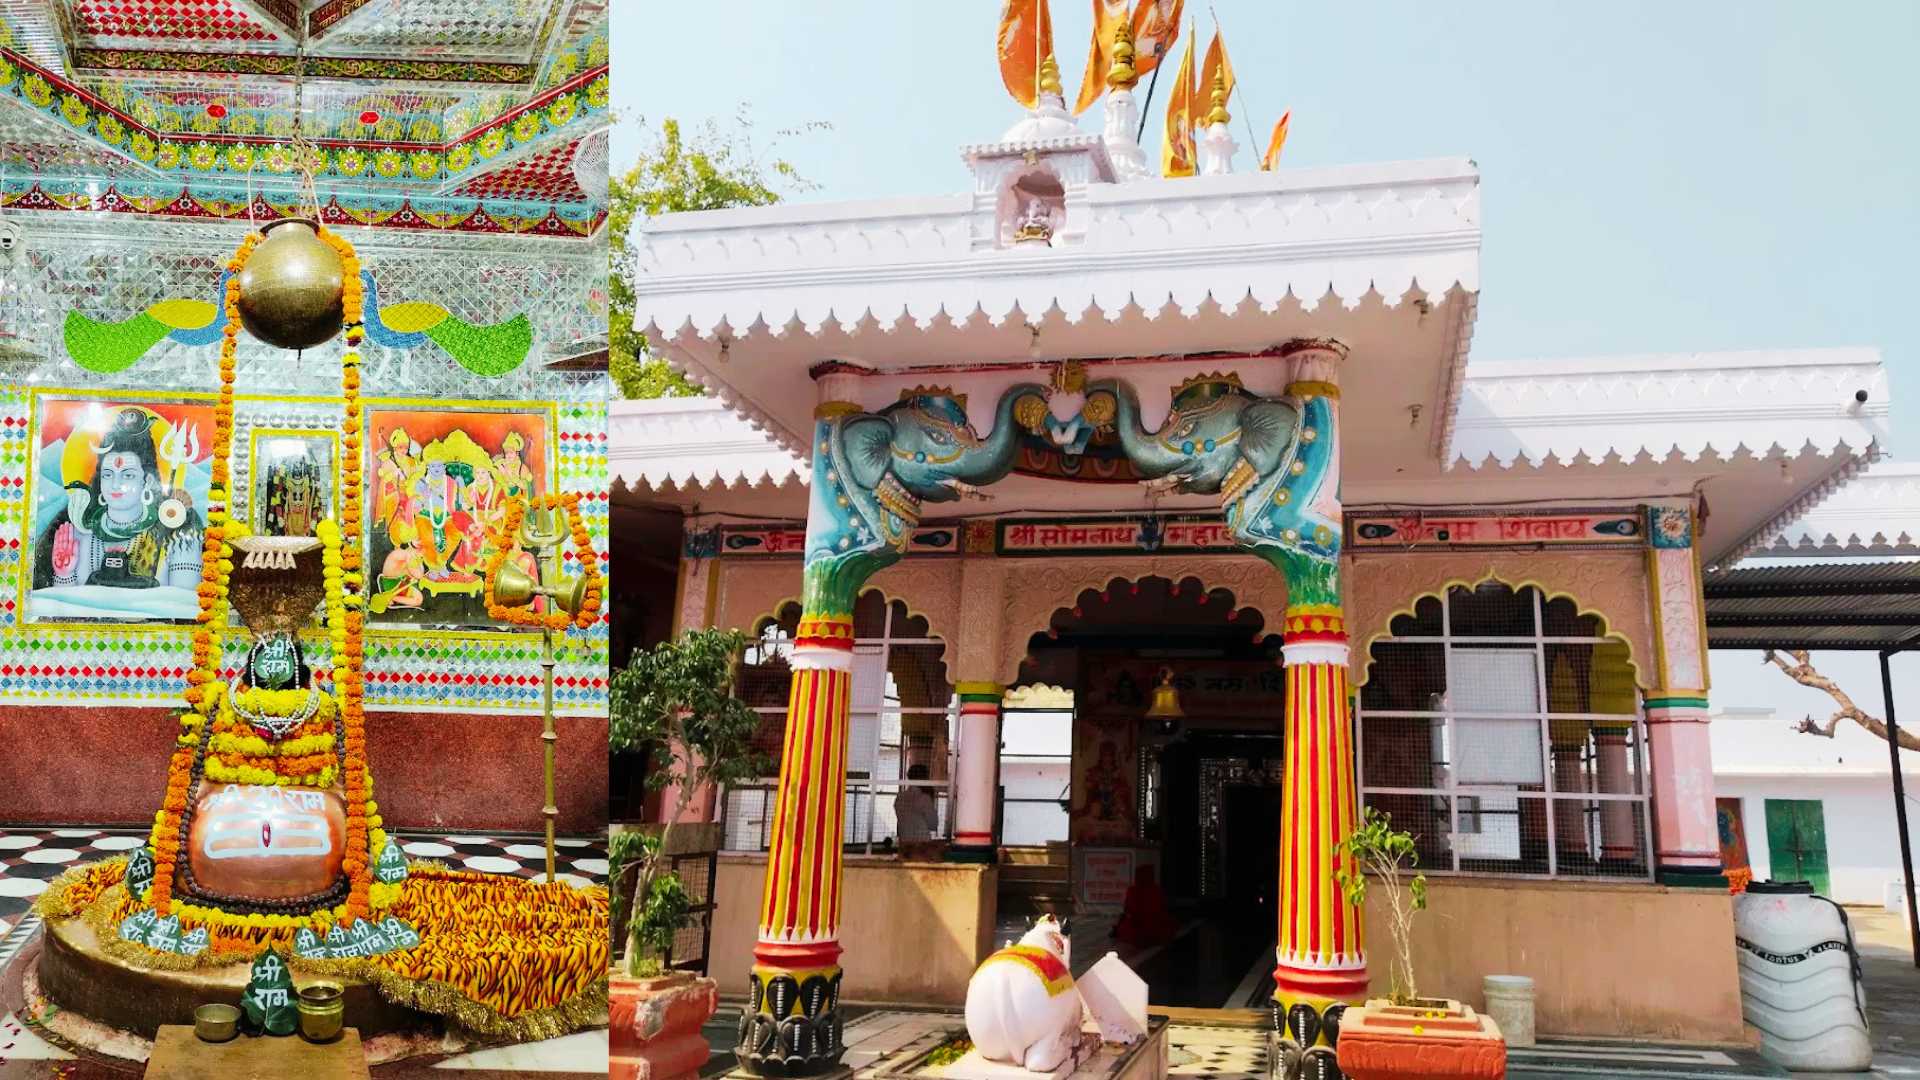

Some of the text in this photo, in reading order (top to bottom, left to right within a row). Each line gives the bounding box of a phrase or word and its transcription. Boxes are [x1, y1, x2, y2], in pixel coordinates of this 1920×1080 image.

[1009, 525, 1036, 546] श्री
[1039, 524, 1135, 547] सोमनाथ
[1496, 517, 1590, 540] शिवाय
[379, 865, 407, 881] राम
[252, 954, 284, 983] श्री
[254, 988, 289, 1011] राम
